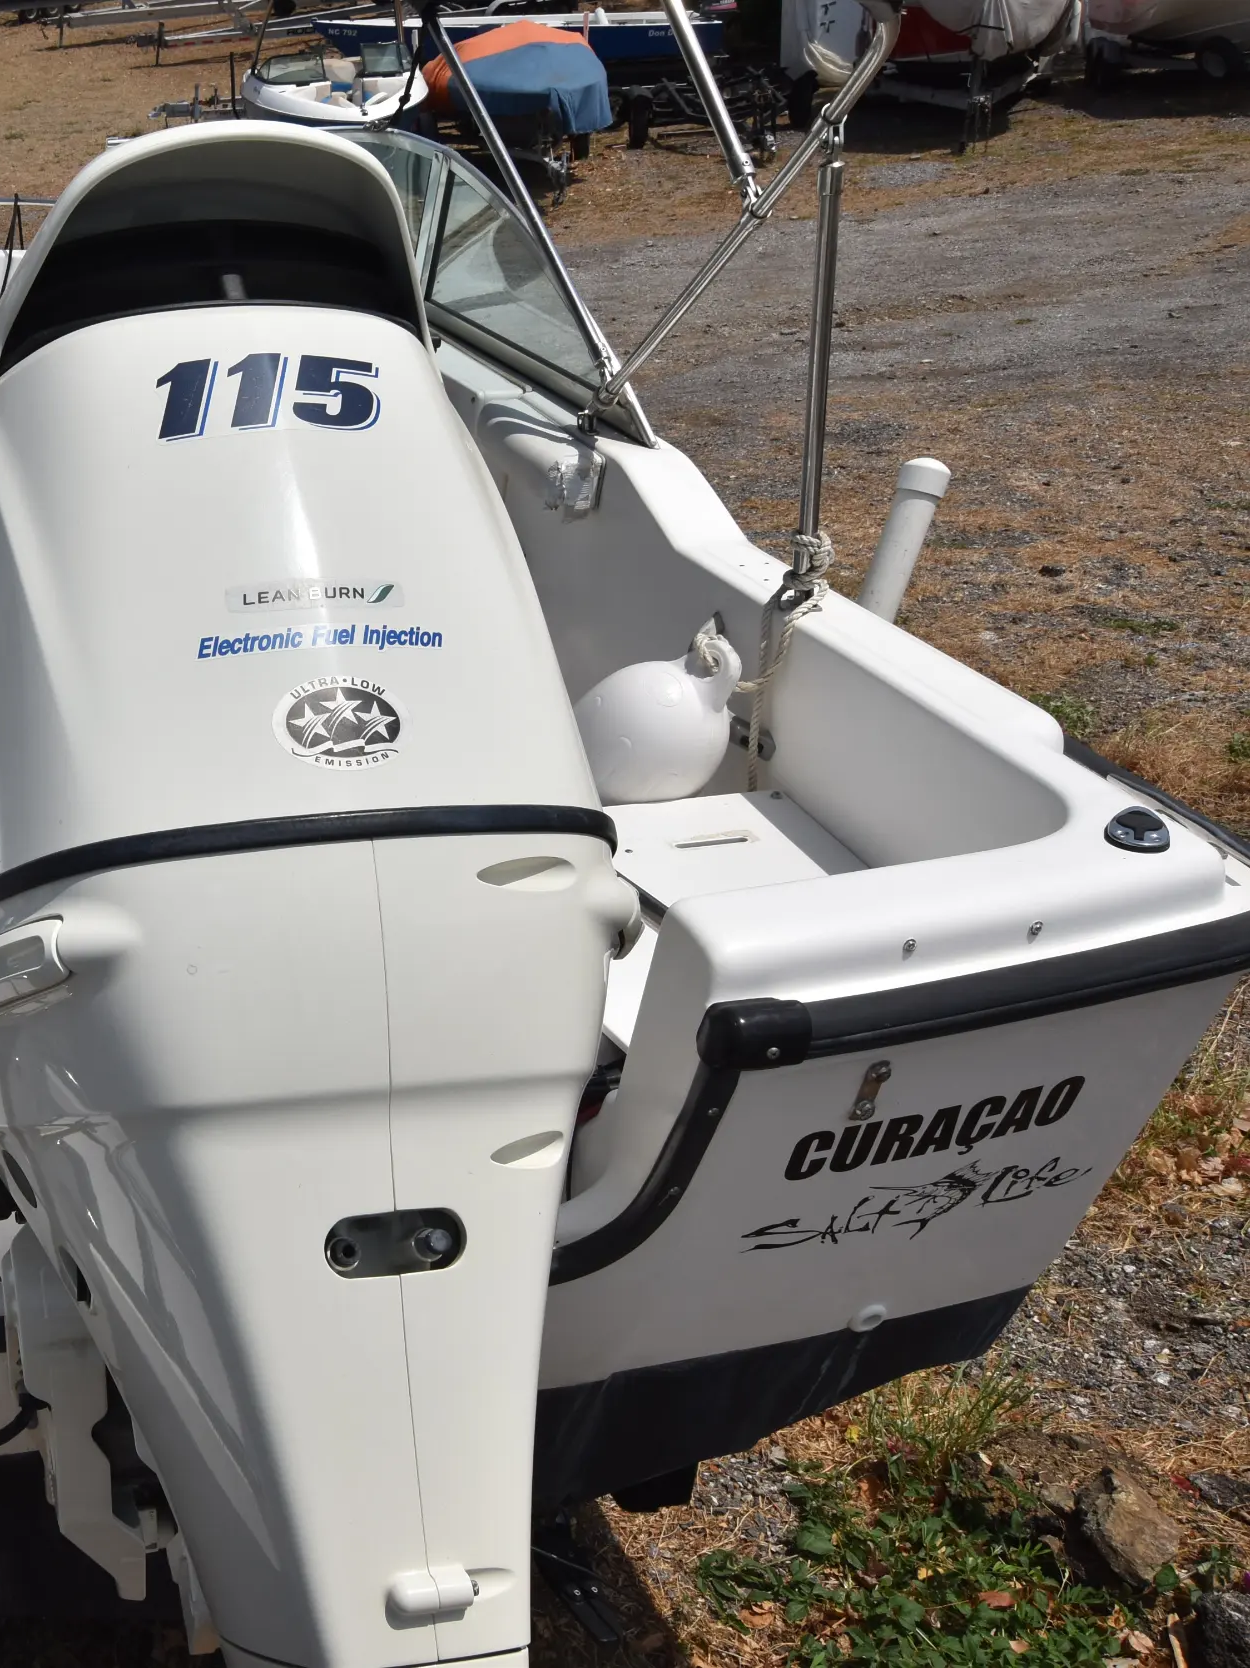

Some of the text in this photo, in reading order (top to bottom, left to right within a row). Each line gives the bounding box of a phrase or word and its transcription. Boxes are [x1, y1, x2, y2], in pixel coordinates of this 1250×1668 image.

[648, 29, 665, 37] Don
[155, 352, 381, 442] 115
[243, 587, 365, 606] LEAN BURN
[197, 624, 443, 660] Electronic Fuel Injection
[290, 676, 386, 699] ULTRA LOW
[314, 751, 390, 767] EMISSION
[784, 1076, 1086, 1181] CURAÇAO
